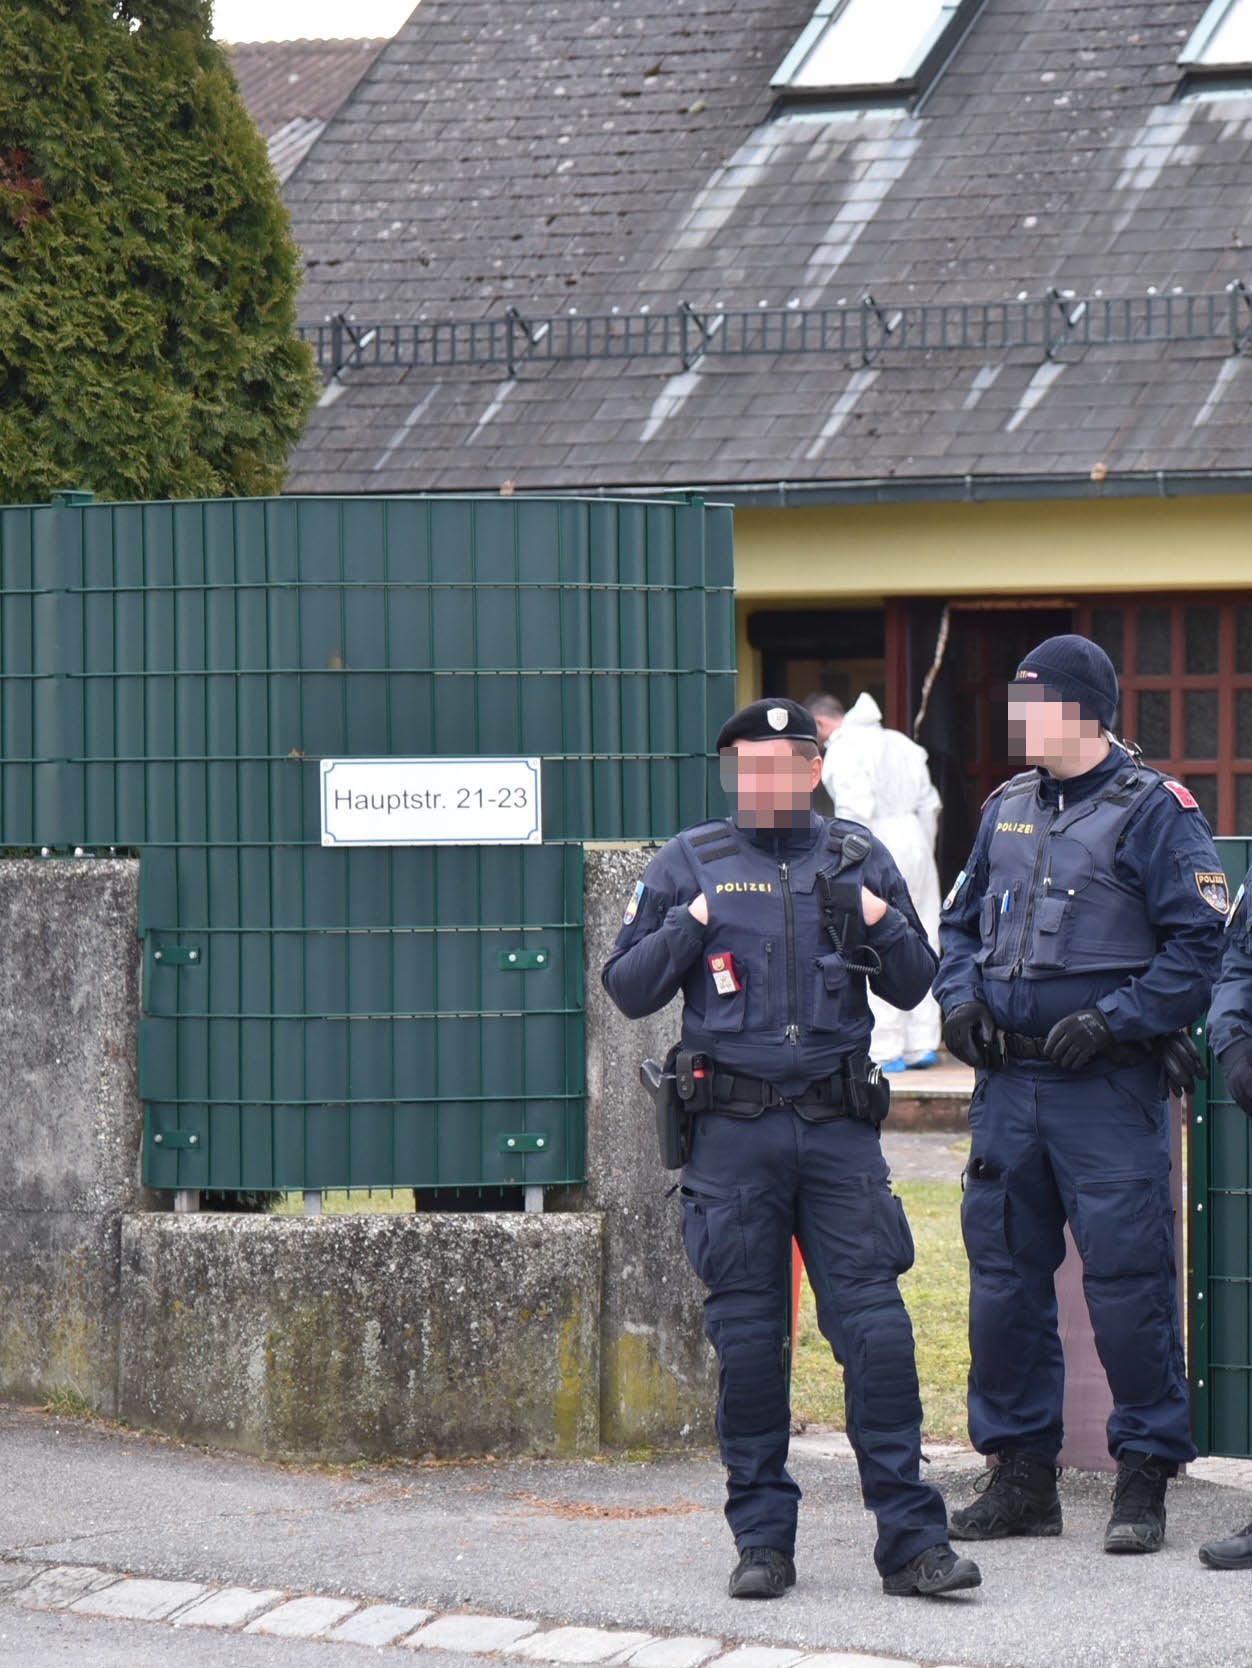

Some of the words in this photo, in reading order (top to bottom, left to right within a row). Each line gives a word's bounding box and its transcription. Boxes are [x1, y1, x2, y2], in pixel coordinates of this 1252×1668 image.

[334, 789, 446, 815] Hauptstr.
[456, 787, 528, 809] 21-23
[995, 822, 1034, 834] POLIZEI
[715, 881, 772, 894] POLIZEI
